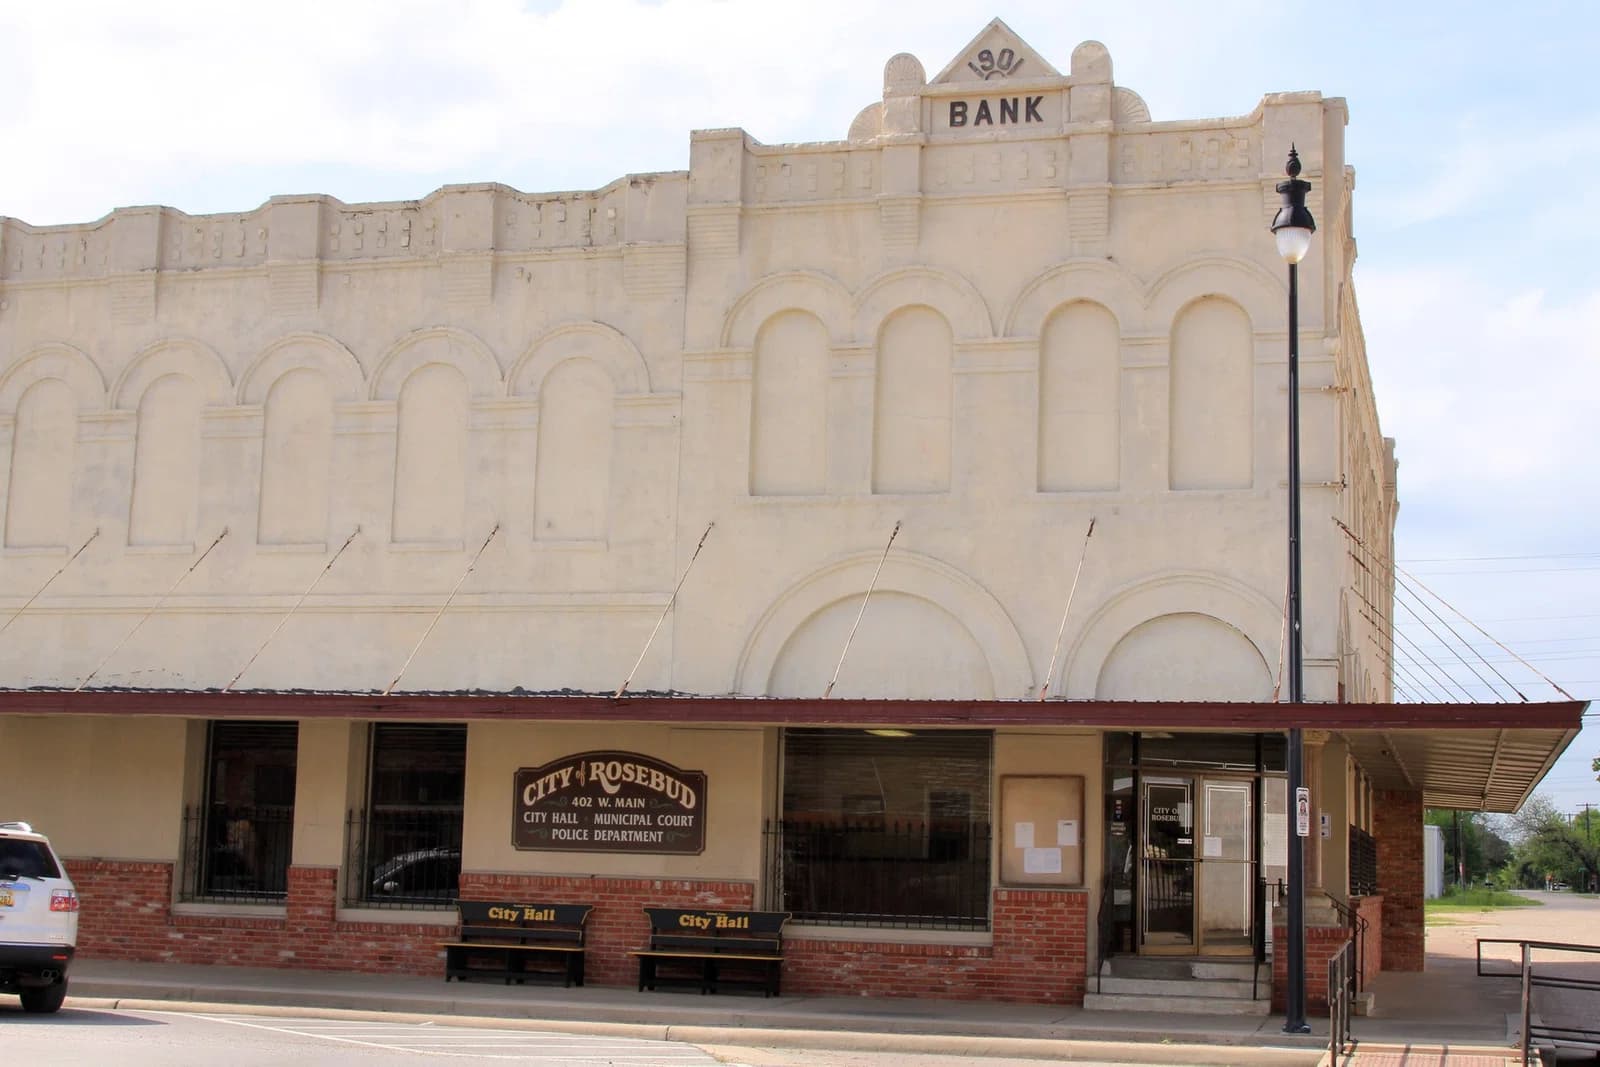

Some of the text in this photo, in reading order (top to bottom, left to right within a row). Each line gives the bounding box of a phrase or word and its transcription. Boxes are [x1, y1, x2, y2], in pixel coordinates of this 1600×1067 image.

[949, 96, 1044, 128] BANK
[523, 760, 697, 810] CITY of ROSEBUD
[571, 796, 646, 809] 402 W. MAIN
[523, 811, 694, 827] CITY HALL MUNICIPAL COURT
[1151, 814, 1182, 822] ROSEBU
[552, 828, 664, 842] POLICE DEPARTMENT
[488, 906, 555, 922] City Hall
[679, 914, 749, 929] City Hall
